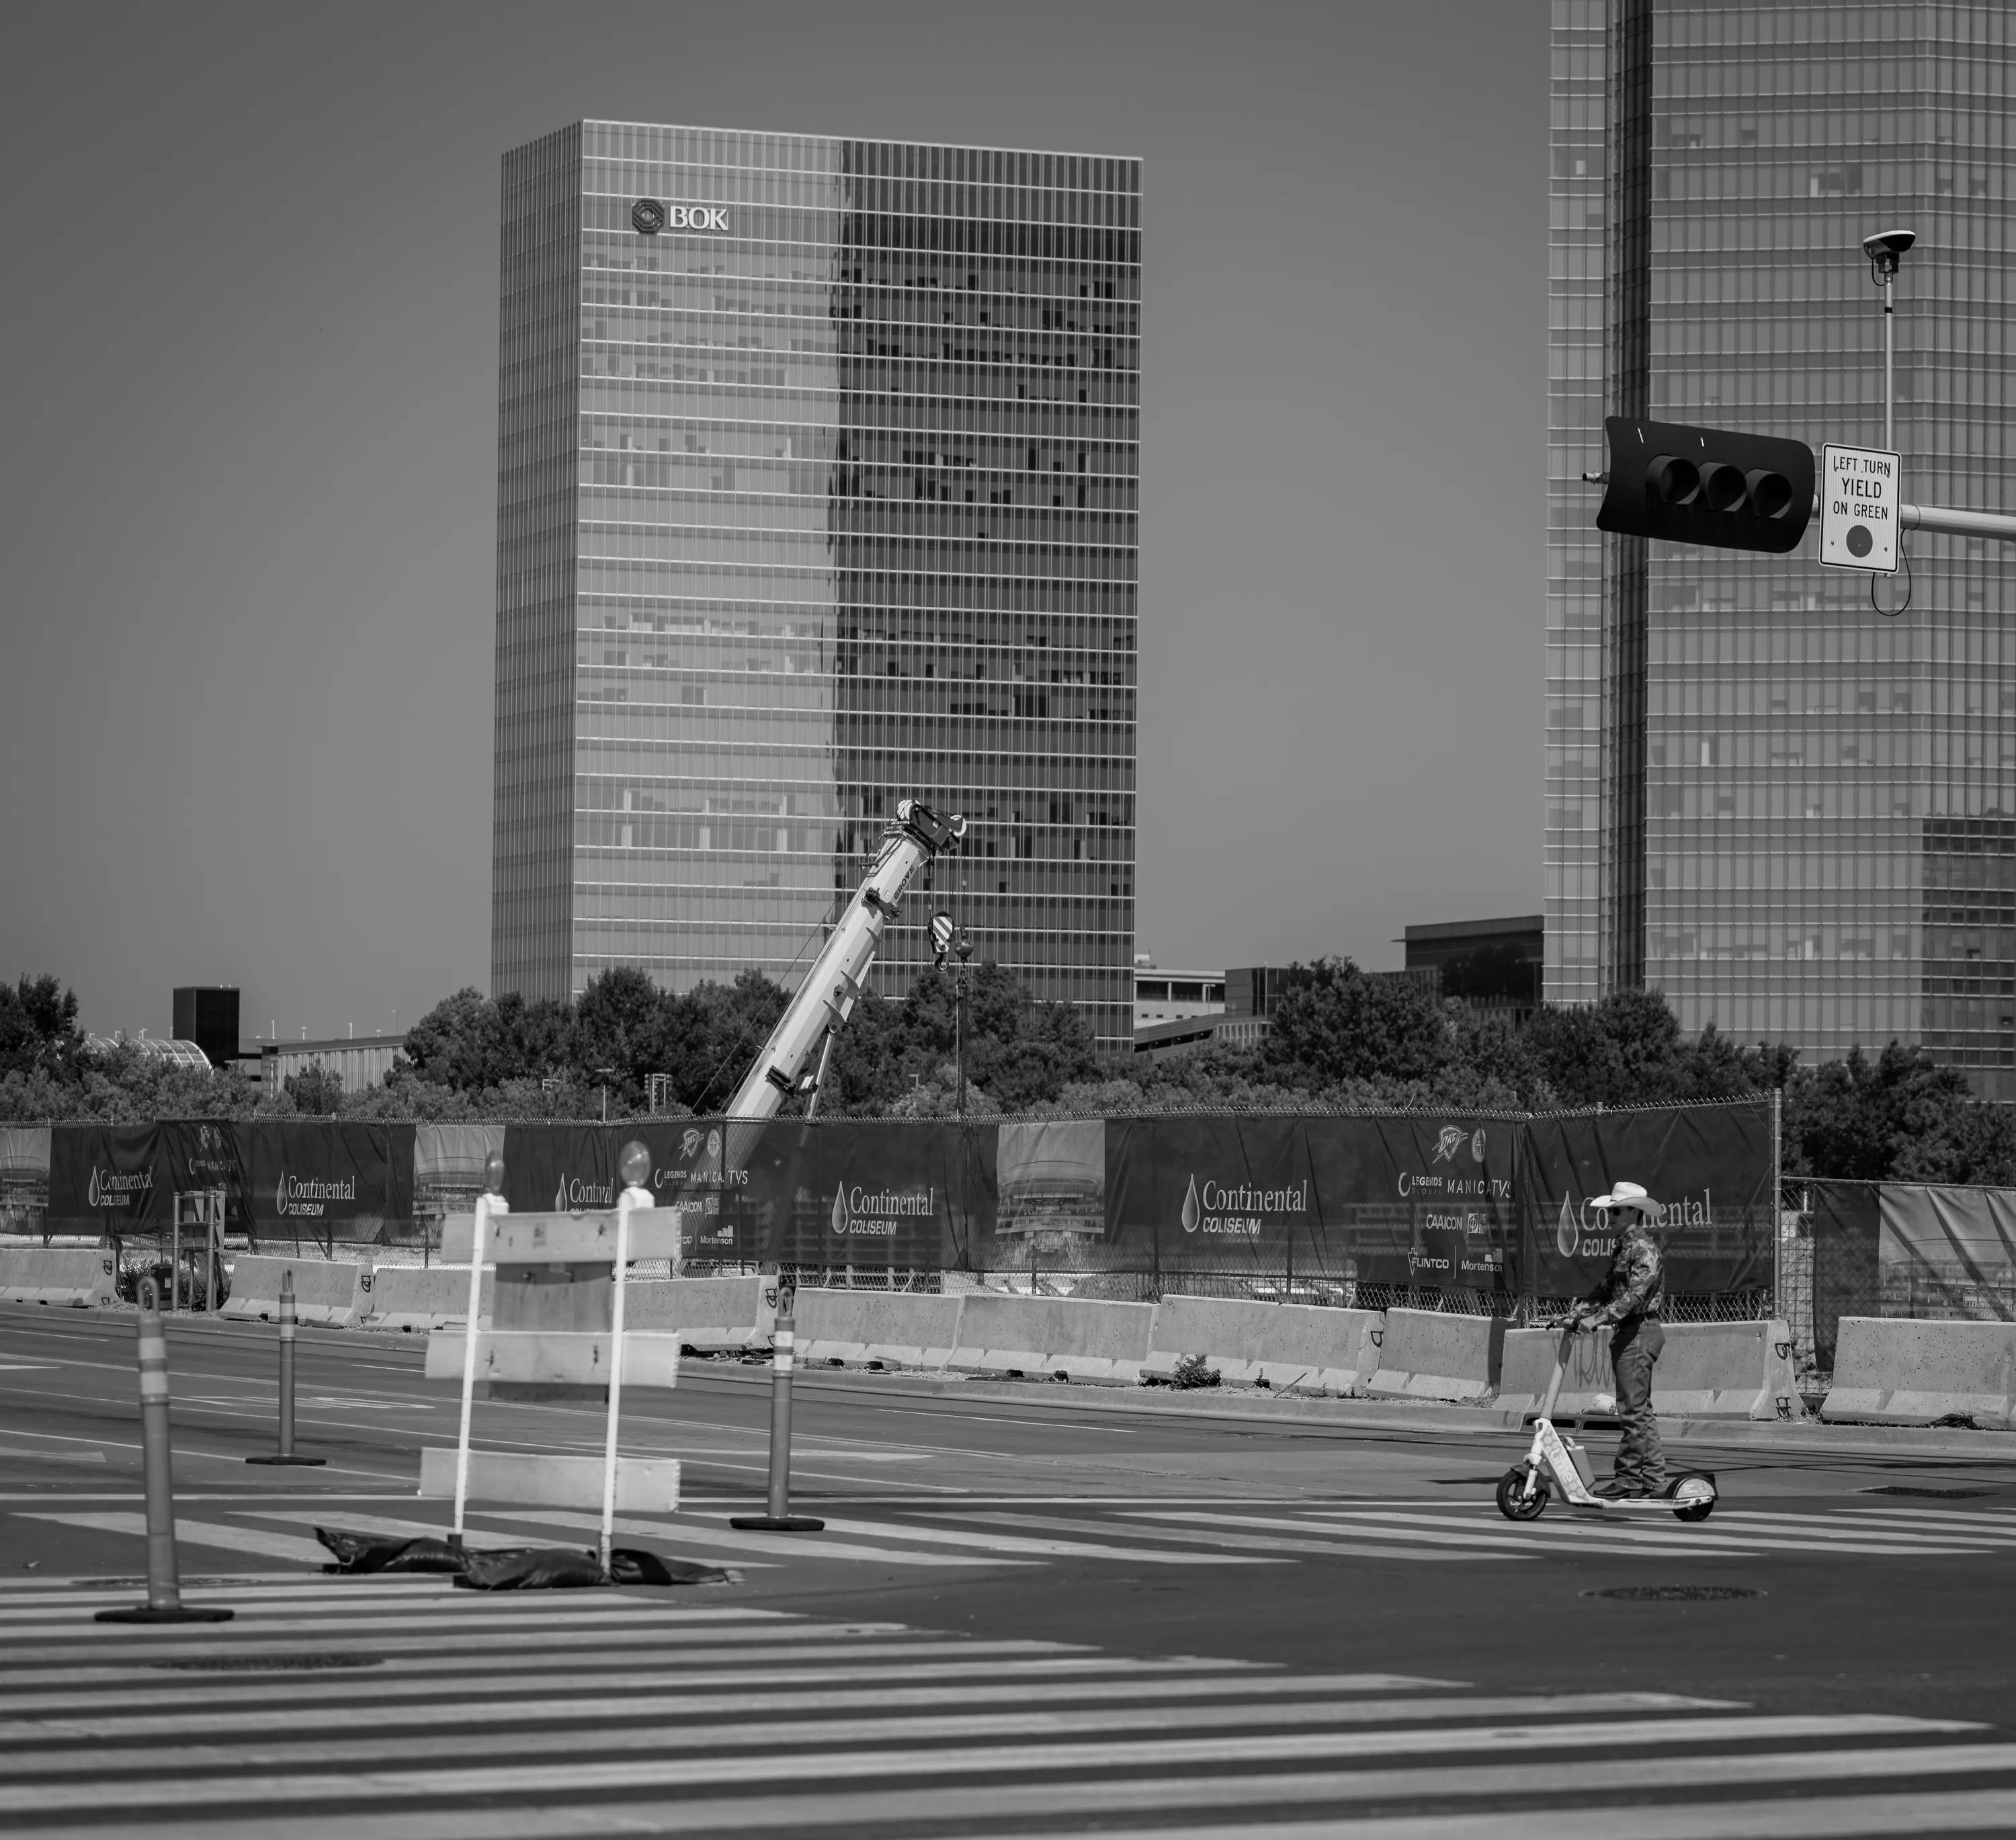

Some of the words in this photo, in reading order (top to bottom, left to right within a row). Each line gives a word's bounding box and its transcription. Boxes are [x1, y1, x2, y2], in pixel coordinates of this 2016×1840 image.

[670, 205, 728, 231] BOK
[1833, 456, 1857, 471] LEFT
[1863, 459, 1890, 475] TURN
[1841, 477, 1882, 499] YIELD
[1833, 501, 1847, 515] ON
[1854, 503, 1888, 520] GREEN
[894, 864, 915, 899] GROVE
[1438, 1132, 1457, 1154] OKC
[664, 1170, 687, 1179] LEGENDS
[728, 1170, 749, 1185] TVS
[1412, 1175, 1442, 1186] LEGENDS
[288, 1175, 355, 1200] Continental
[1203, 1179, 1307, 1212] Continental
[1411, 1187, 1441, 1196] GLOBAL
[1490, 1179, 1511, 1199] TVS
[288, 1203, 325, 1216] COLISEUM
[850, 1186, 933, 1216] Continental
[849, 1220, 897, 1235] COLISEUM
[1203, 1217, 1261, 1234] COLISEUM
[700, 1235, 733, 1245] Mortenson
[1411, 1257, 1449, 1269] FLINTCO
[1462, 1260, 1502, 1272] Mortenson
[1550, 1448, 1573, 1484] Lime
